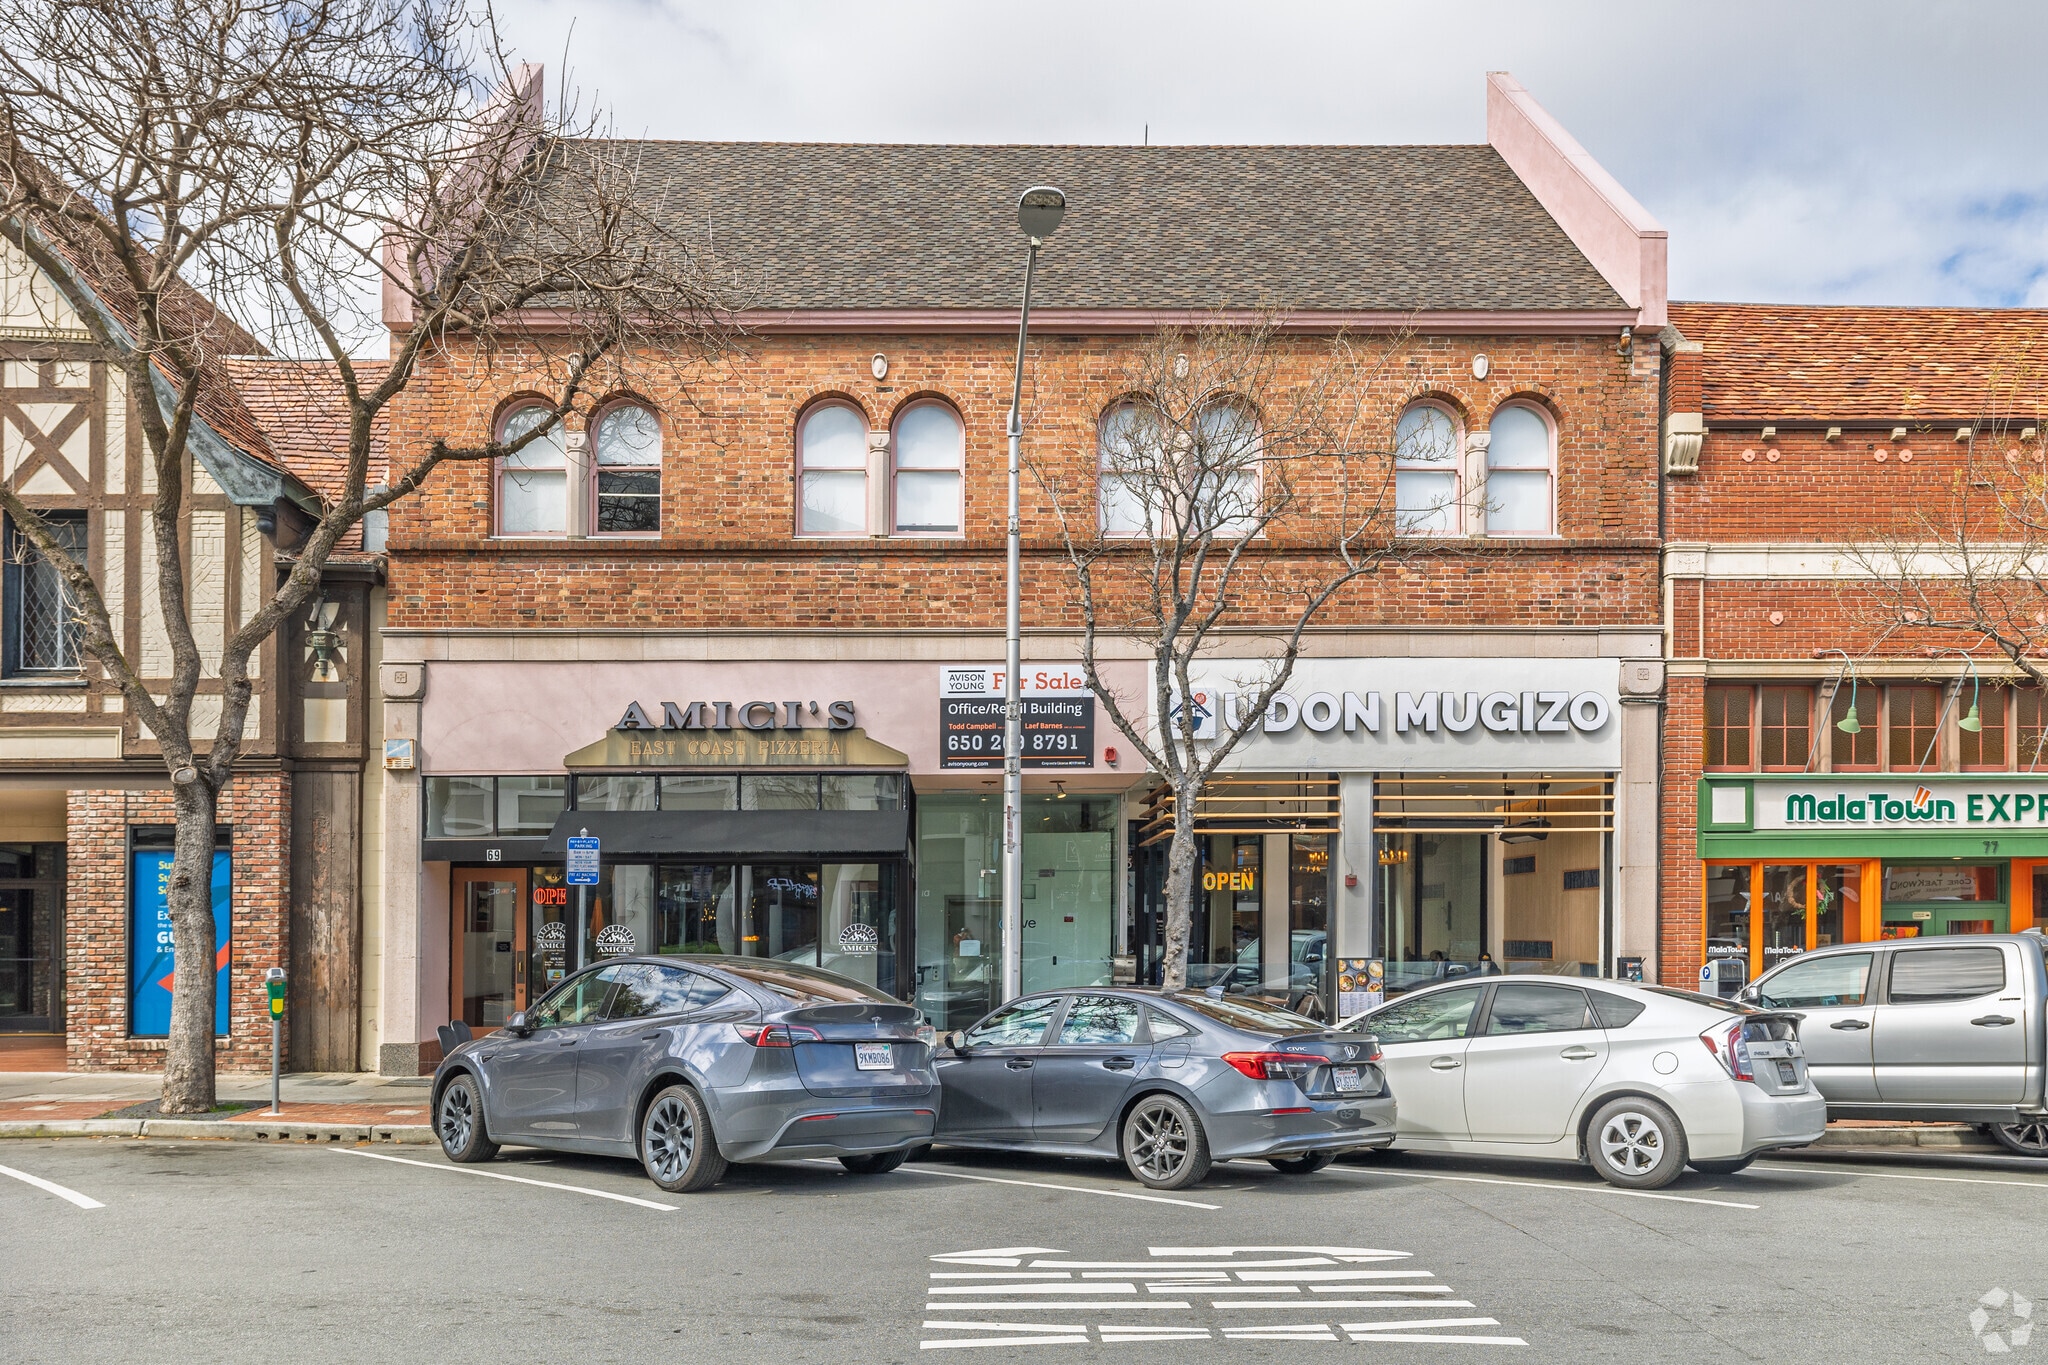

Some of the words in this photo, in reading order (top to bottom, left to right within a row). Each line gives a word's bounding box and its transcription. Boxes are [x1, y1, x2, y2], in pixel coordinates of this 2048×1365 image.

[949, 674, 985, 682] AVISON
[992, 672, 1028, 690] Fr
[1035, 672, 1082, 690] Sale
[949, 682, 985, 690] YOUNG
[614, 700, 856, 731] AMICI'S
[948, 703, 1027, 715] Office/Reil
[1030, 702, 1083, 717] Building
[1223, 691, 1381, 732] UDON
[1395, 691, 1610, 732] MUGIZO
[966, 723, 997, 731] Campbell
[630, 740, 676, 756] EAST
[688, 740, 746, 756] COAST
[758, 740, 841, 756] PIZZERIA
[948, 735, 983, 751] 650
[1033, 734, 1078, 750] 8791
[1785, 791, 1957, 823] MalaTown
[487, 849, 501, 861] 69
[1982, 841, 1999, 855] 77
[1203, 872, 1254, 891] OPEN
[533, 888, 567, 905] OPE
[1708, 945, 1748, 954] MalaTown
[1764, 946, 1804, 955] MalaTown
[1704, 969, 1709, 977] P
